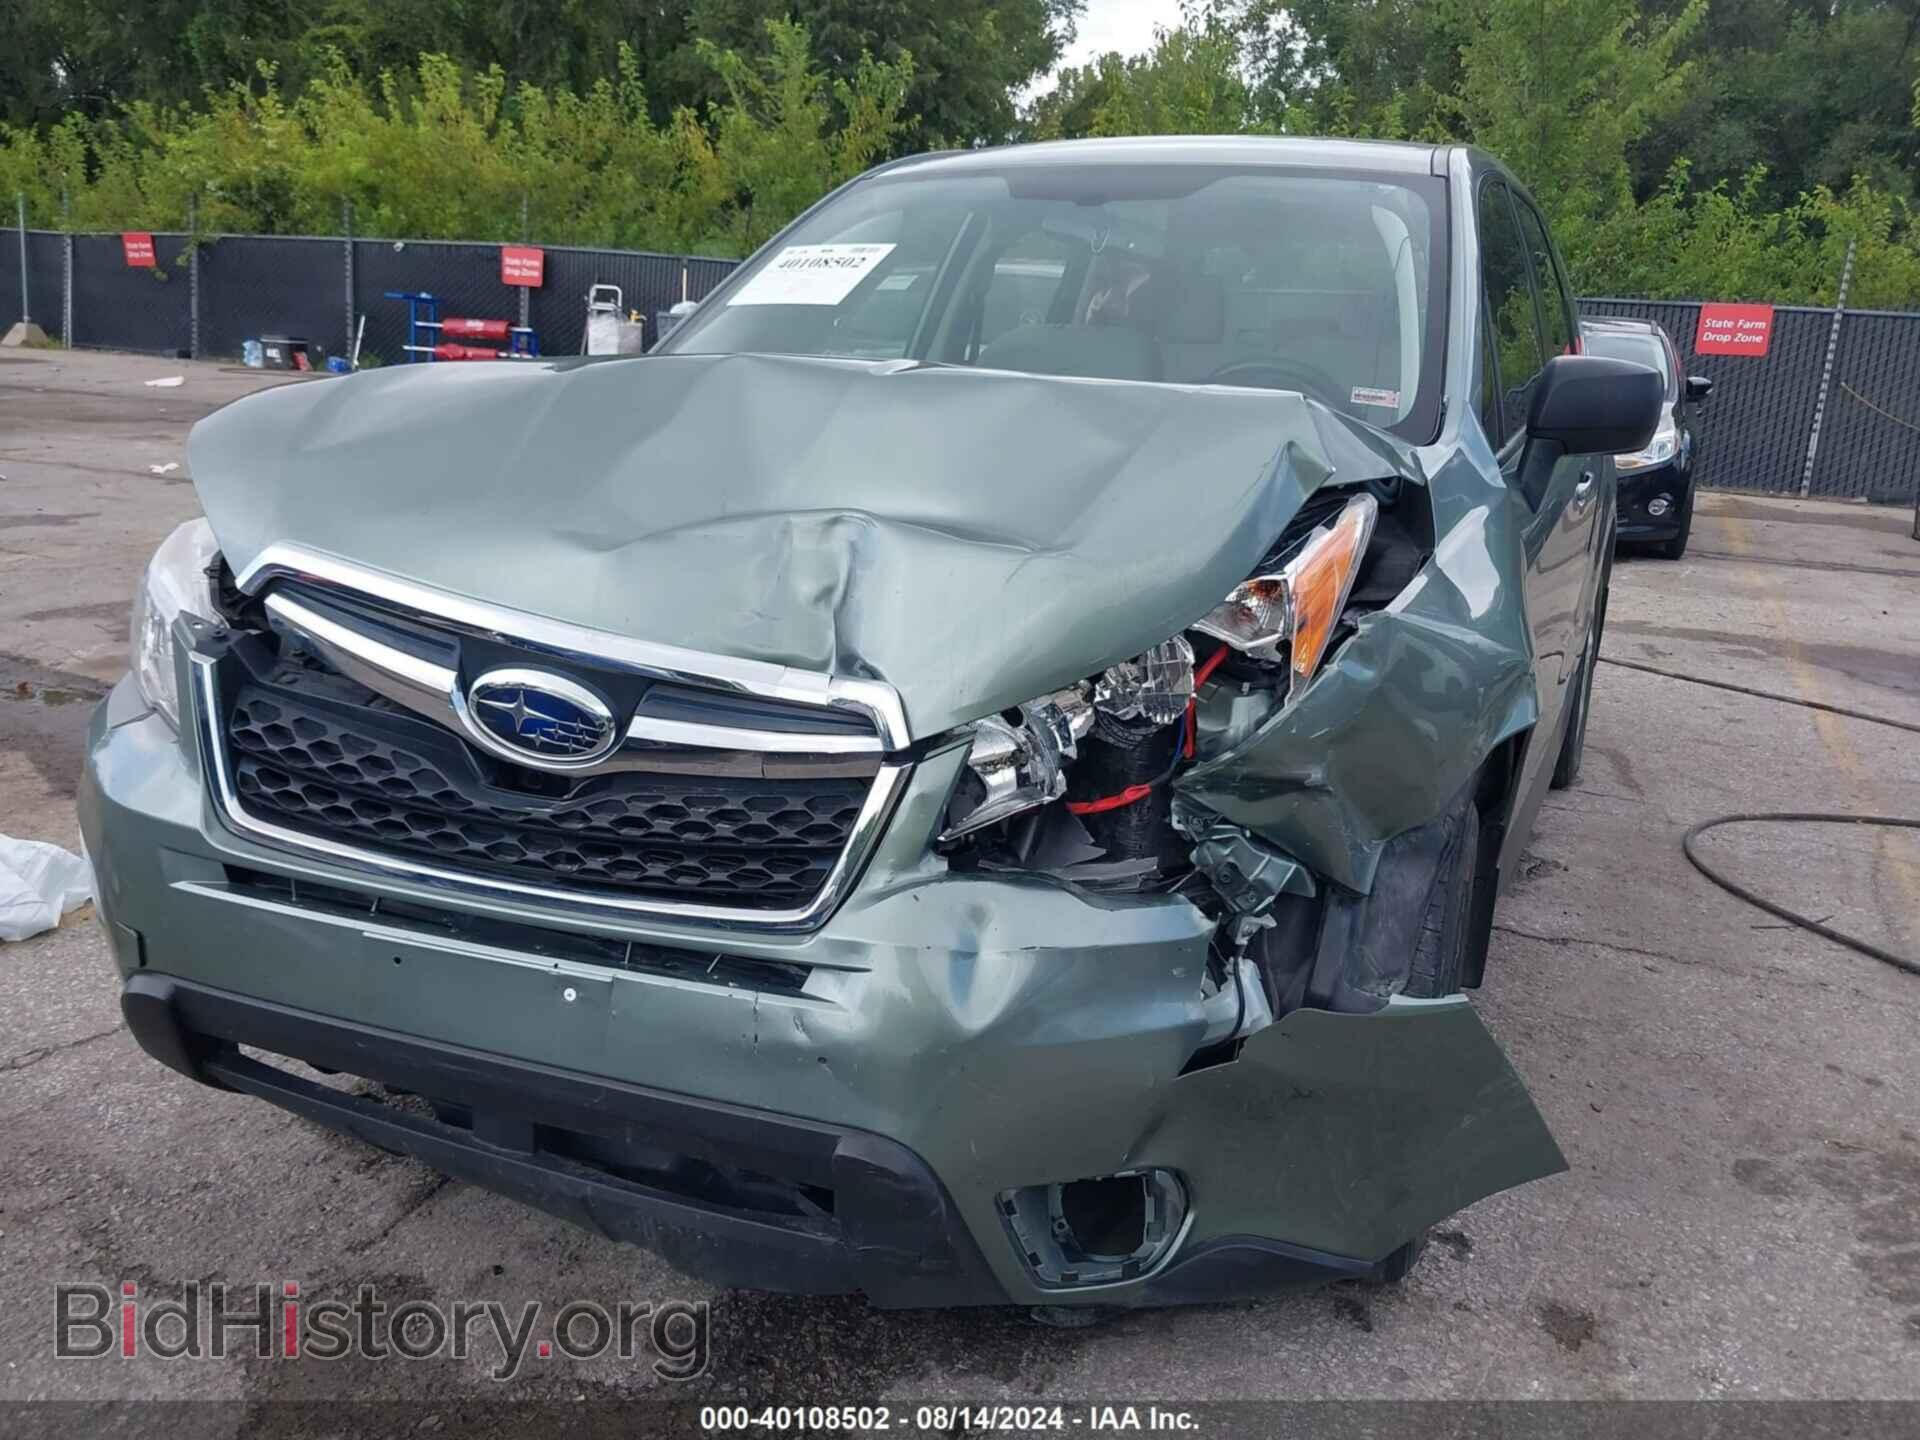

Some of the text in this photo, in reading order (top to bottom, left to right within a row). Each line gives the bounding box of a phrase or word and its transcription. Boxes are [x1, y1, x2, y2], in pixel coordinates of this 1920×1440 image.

[1704, 318, 1767, 329] State Farm
[1703, 331, 1764, 343] Drop Zone
